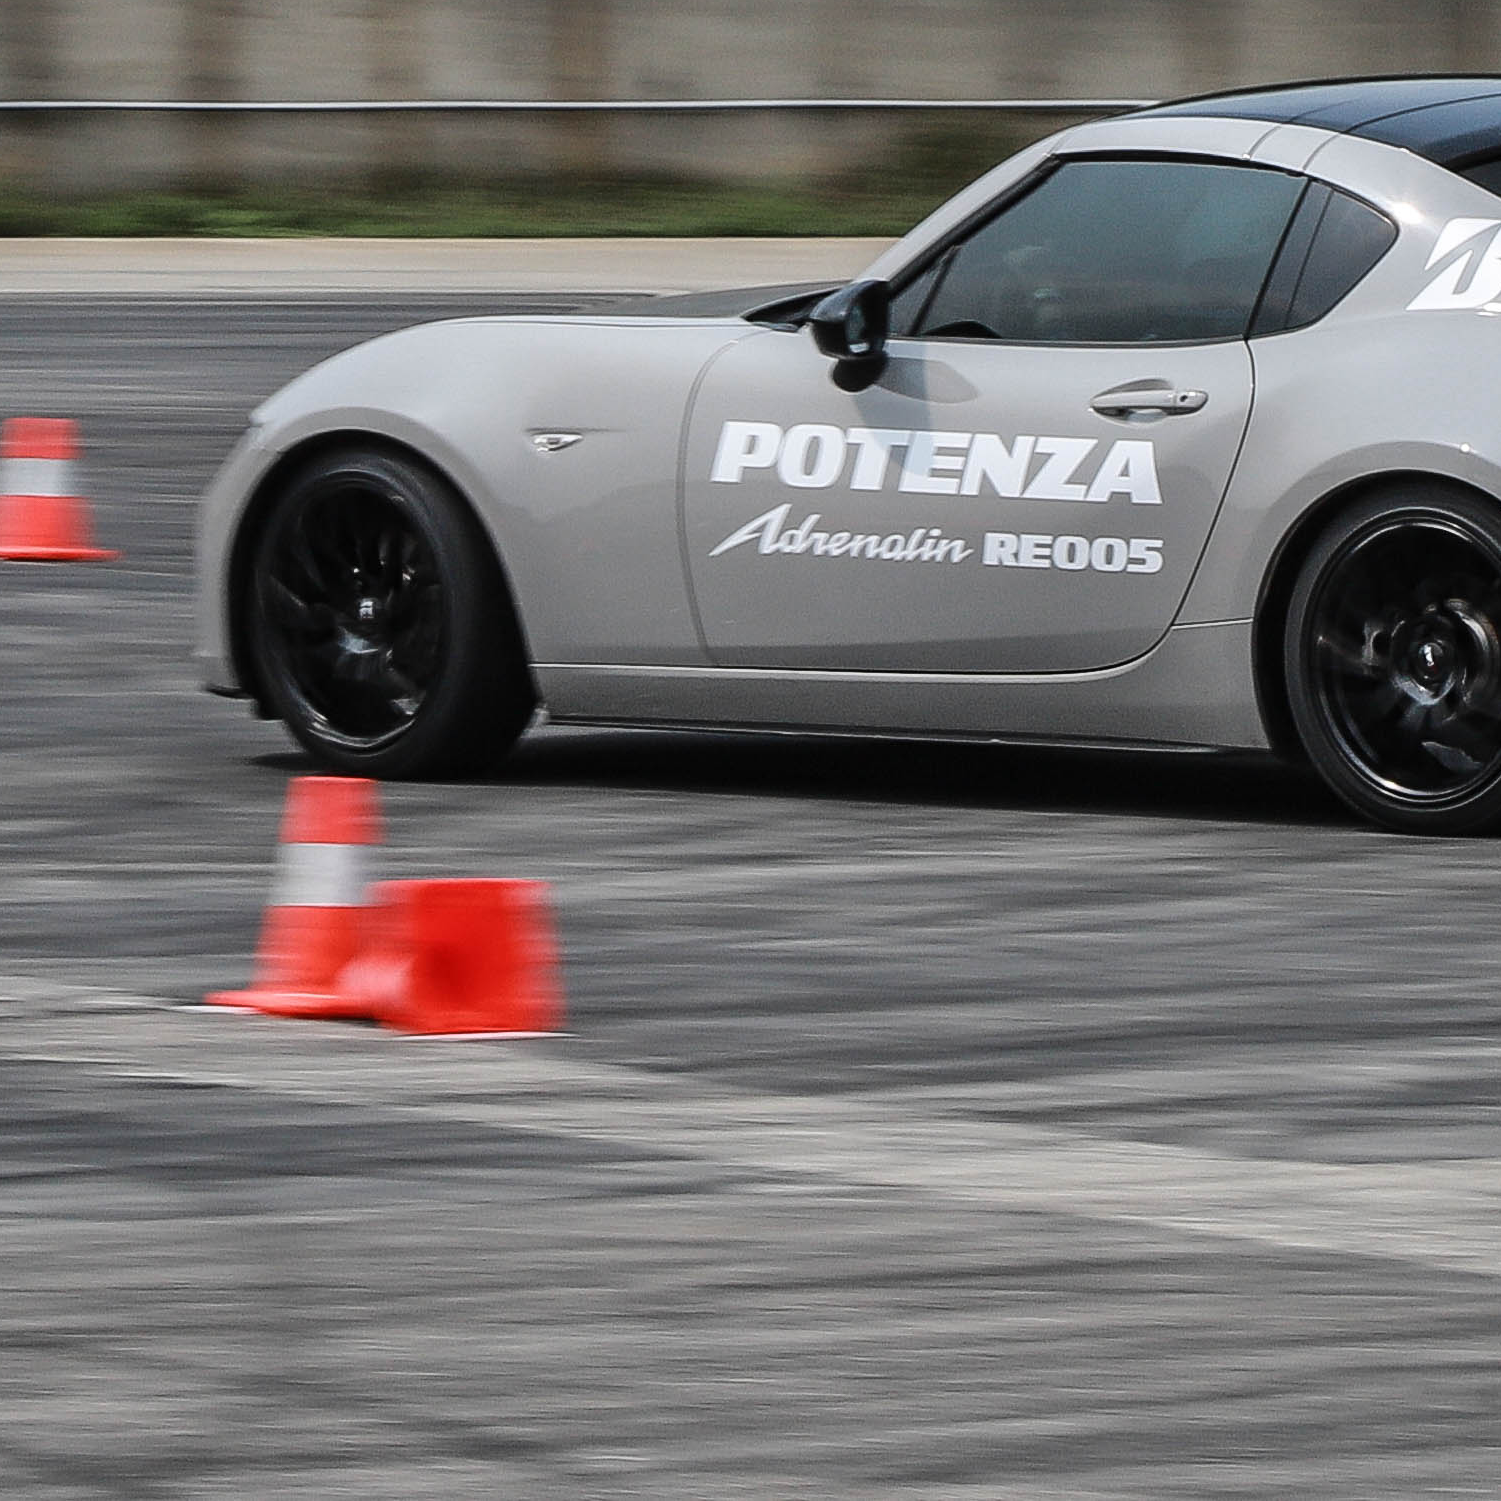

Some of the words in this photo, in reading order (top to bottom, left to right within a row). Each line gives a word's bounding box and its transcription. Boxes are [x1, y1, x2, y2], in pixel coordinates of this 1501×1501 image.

[710, 420, 1163, 505] POTENZA
[709, 503, 974, 565] Adrenalin
[982, 532, 1164, 575] RE005
